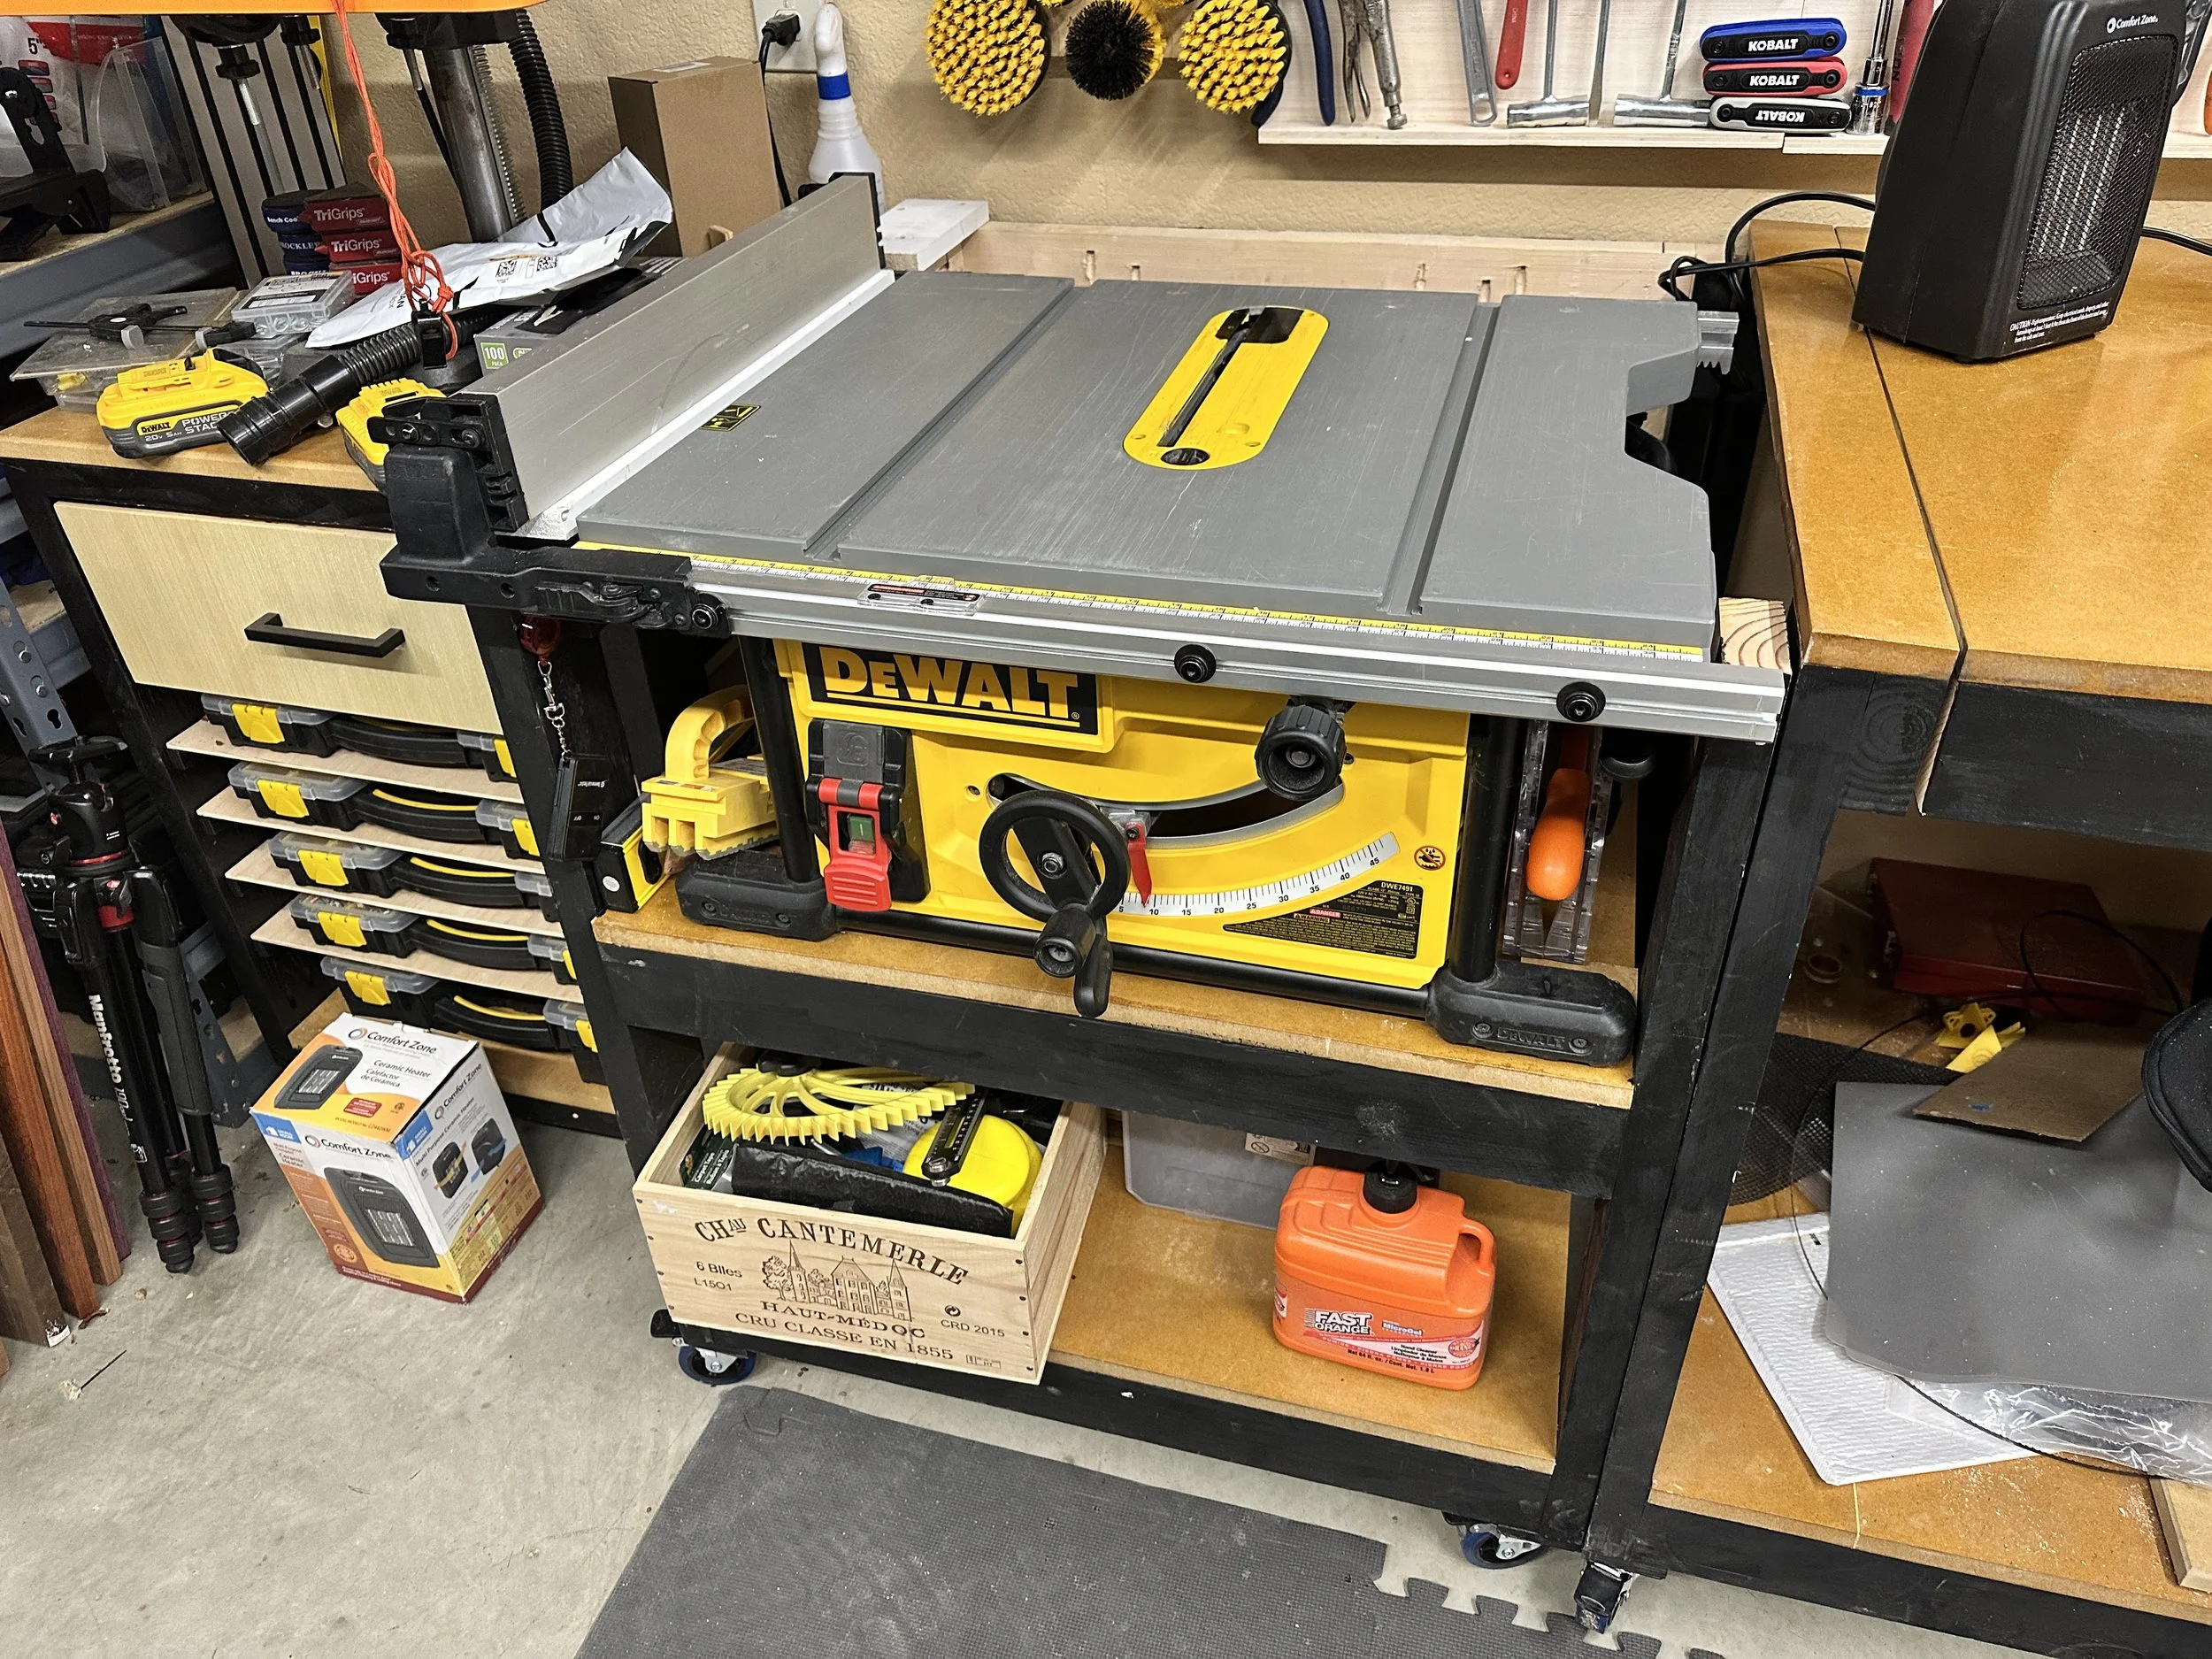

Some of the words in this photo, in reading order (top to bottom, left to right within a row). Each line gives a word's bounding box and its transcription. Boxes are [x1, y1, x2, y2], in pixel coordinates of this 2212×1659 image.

[2116, 16, 2140, 29] Comfort
[2140, 15, 2156, 25] Zone
[1747, 39, 1798, 51] KOBALT
[1749, 75, 1800, 86] KOBALT
[1755, 110, 1805, 122] KOBALT
[314, 207, 365, 221] TriGrips
[331, 239, 380, 252] TriGrips
[352, 272, 389, 285] iGrips
[486, 347, 503, 359] 100
[141, 422, 171, 434] DEWALT
[184, 422, 218, 434] STAC
[819, 646, 1078, 718] DEWALT
[1310, 885, 1320, 894] 35
[1340, 872, 1350, 881] 40
[1369, 857, 1379, 866] 45
[1381, 882, 1413, 892] DWE7491
[88, 995, 122, 1083] Manfrotto
[367, 1032, 409, 1047] Comfort
[409, 1041, 437, 1054] Zone
[366, 1069, 399, 1079] Calefactor
[373, 1060, 404, 1071] Ceramic
[404, 1067, 431, 1078] Heater
[443, 1079, 467, 1107] Comfort
[466, 1063, 482, 1080] Zone
[320, 1138, 363, 1155] Comfort
[363, 1148, 391, 1159] Zone
[757, 1217, 970, 1286] CANTEMERLE
[696, 1261, 704, 1271] 6
[1315, 1310, 1371, 1325] FAST
[941, 1318, 970, 1332] CRD
[973, 1324, 1006, 1338] 2015
[1315, 1322, 1370, 1334] ORANGE
[1382, 1321, 1423, 1336] MicroGel
[735, 1312, 777, 1328] CRU
[784, 1320, 863, 1343] CLASSE
[870, 1336, 896, 1350] EN
[907, 1342, 954, 1360] 1855
